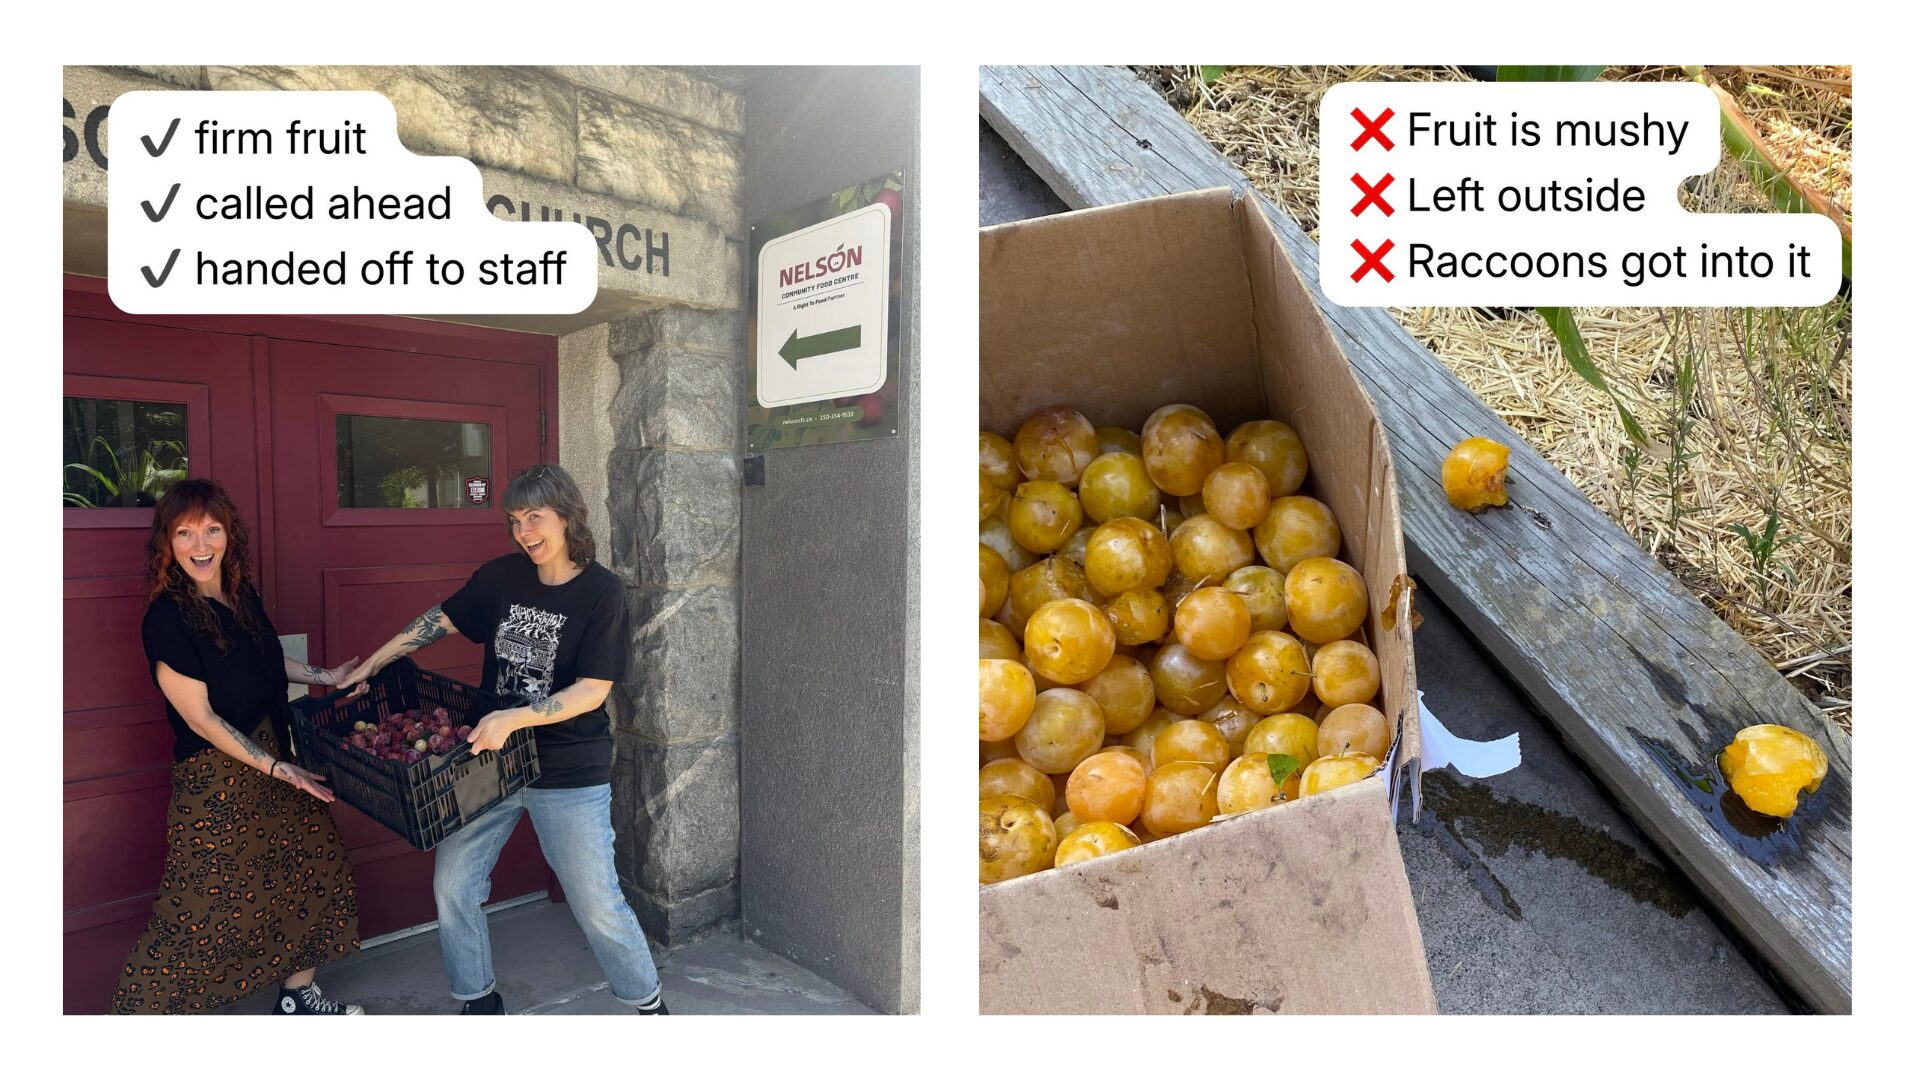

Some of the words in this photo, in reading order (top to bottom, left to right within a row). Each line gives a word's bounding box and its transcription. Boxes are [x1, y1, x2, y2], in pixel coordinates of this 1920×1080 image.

[487, 194, 669, 277] RCH
[779, 244, 863, 288] NELSON
[781, 285, 816, 300] COMMUNITY
[816, 280, 833, 290] FOOD
[833, 272, 860, 285] CENTRE
